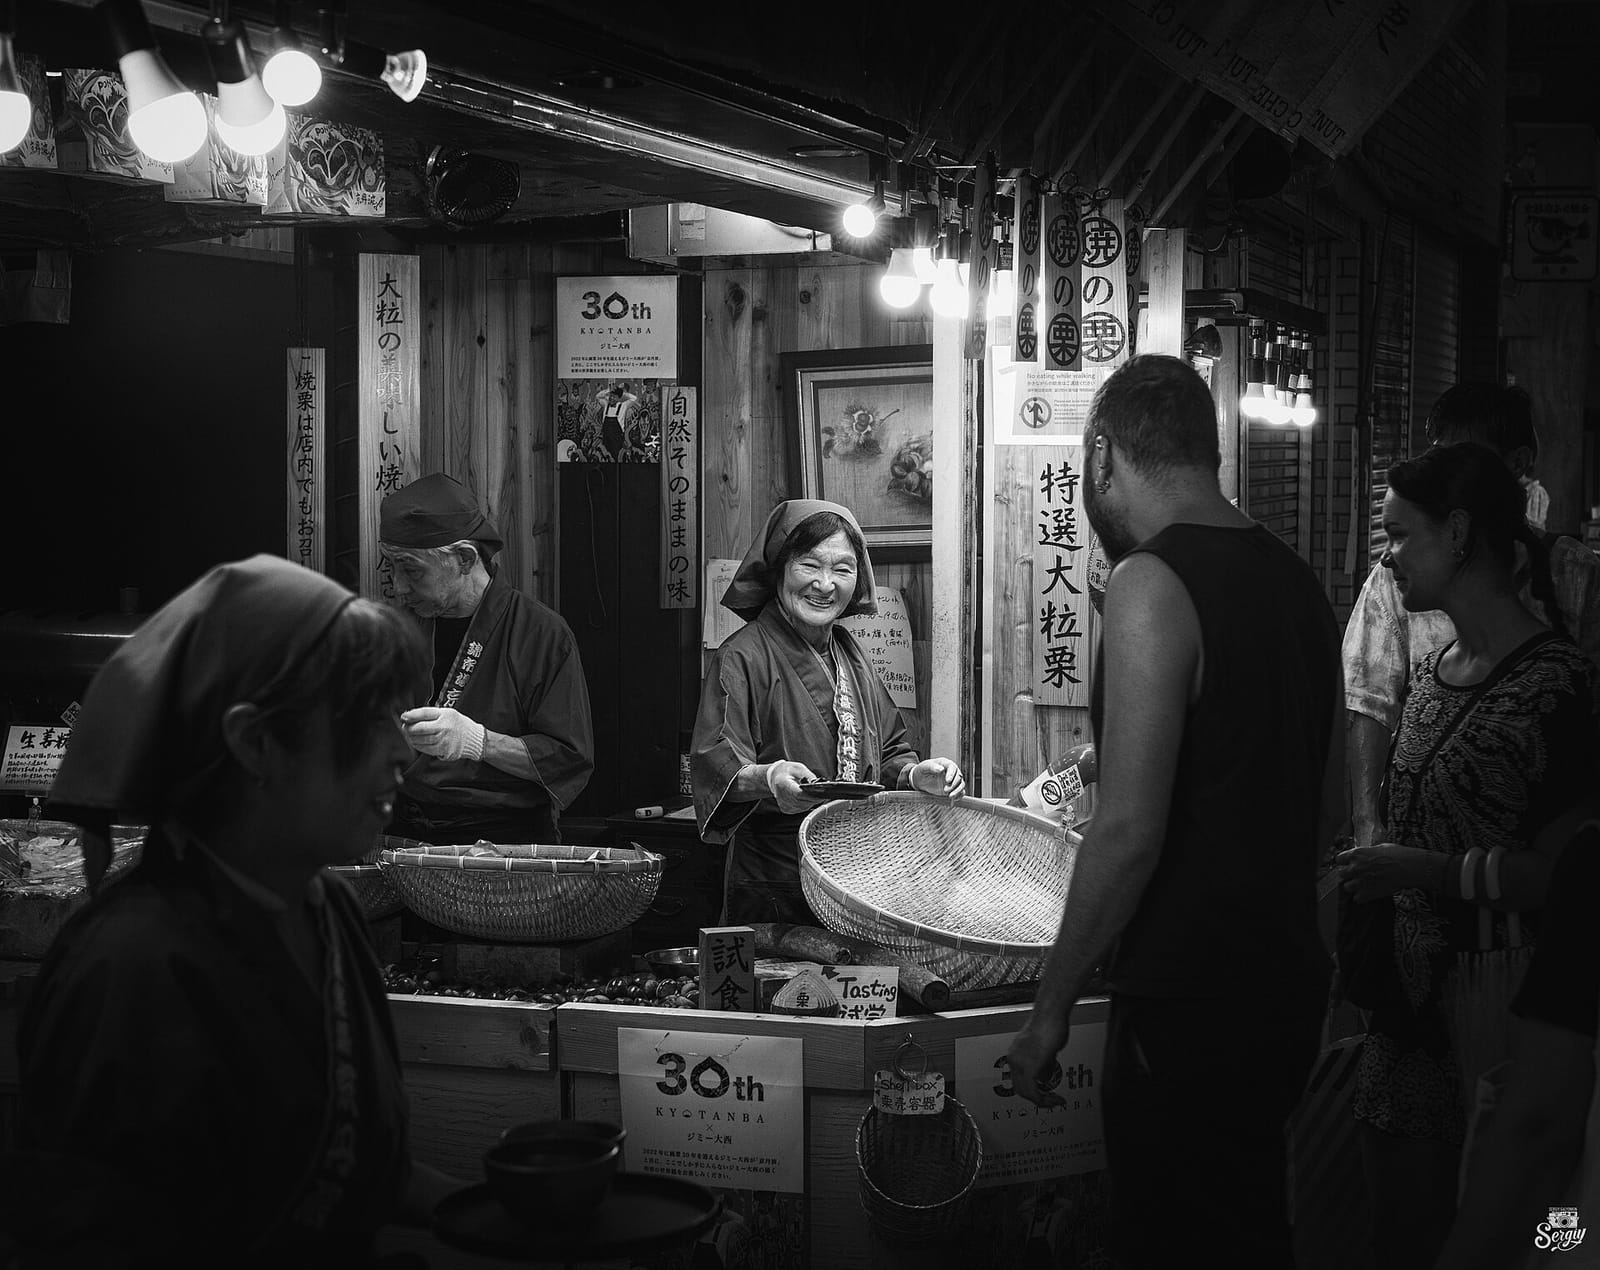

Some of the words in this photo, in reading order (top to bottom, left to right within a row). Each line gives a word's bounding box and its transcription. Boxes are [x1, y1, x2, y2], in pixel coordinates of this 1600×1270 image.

[581, 291, 652, 320] 30th
[1073, 372, 1096, 380] walking
[667, 388, 692, 602] 自然そのままの味
[1038, 461, 1084, 689] 特選大粒栗
[711, 936, 749, 1010] 試食
[836, 976, 897, 1002] Tasting
[656, 1052, 765, 1102] 30th
[687, 1133, 732, 1145] ジミー大西
